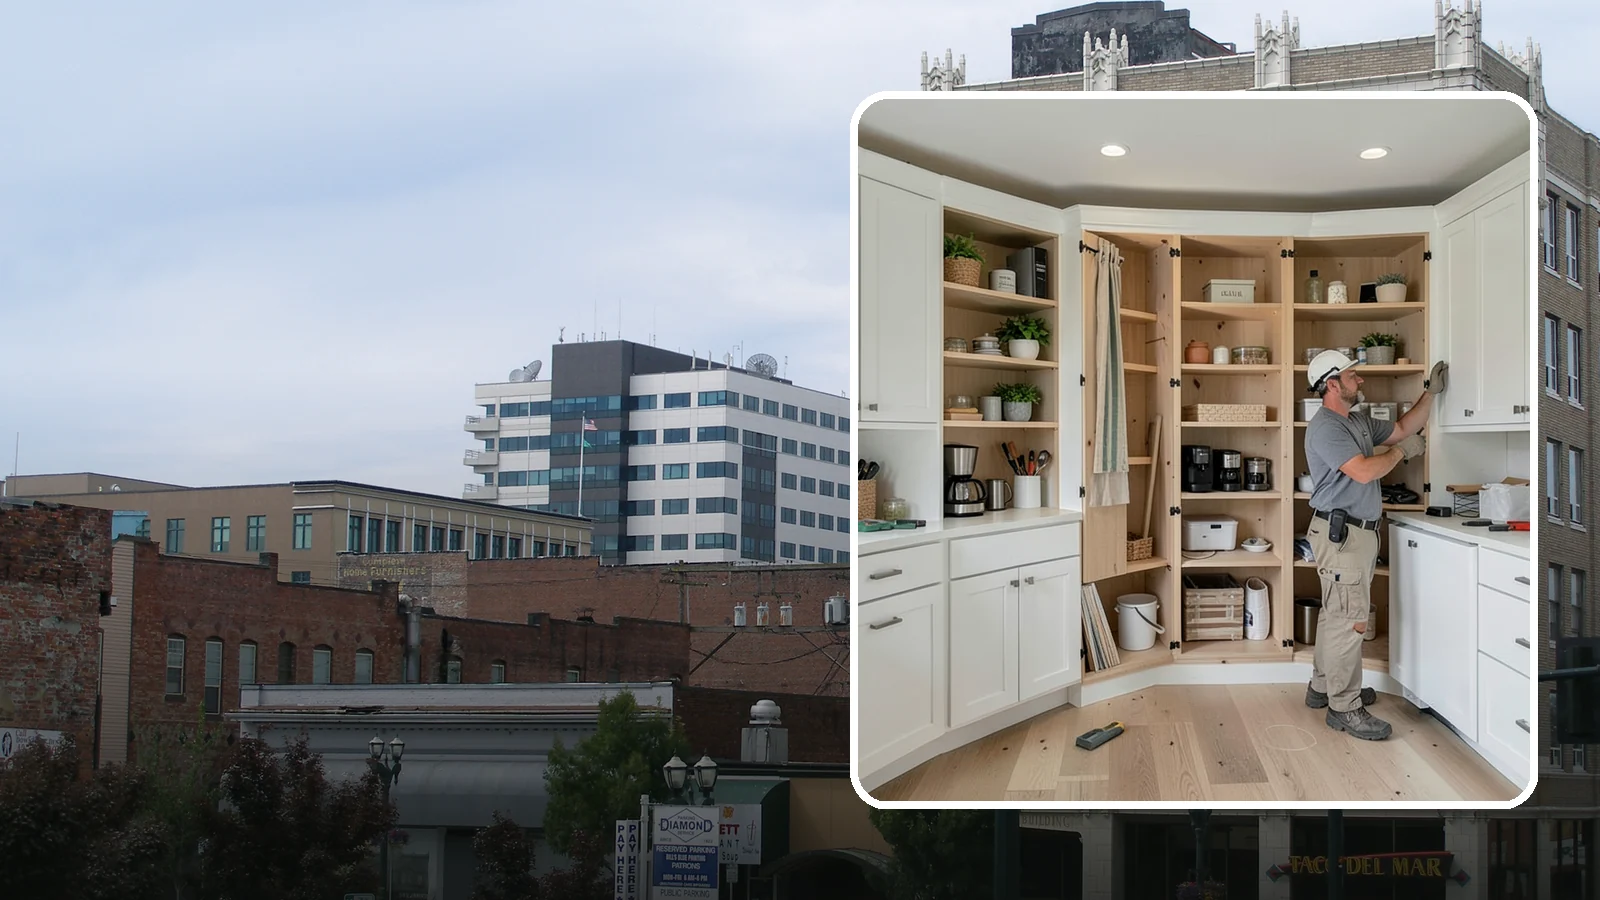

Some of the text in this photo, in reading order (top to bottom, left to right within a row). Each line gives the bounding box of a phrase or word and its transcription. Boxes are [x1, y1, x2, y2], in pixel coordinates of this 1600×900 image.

[370, 566, 427, 576] Furnishers
[660, 818, 713, 832] DIAMOND
[1022, 814, 1069, 828] BUILDING
[655, 845, 716, 854] RESERVED PARKING
[671, 862, 701, 870] PATRONS
[1289, 855, 1442, 878] TAC DEL MAR
[660, 888, 710, 898] PUBLIC PARKING
